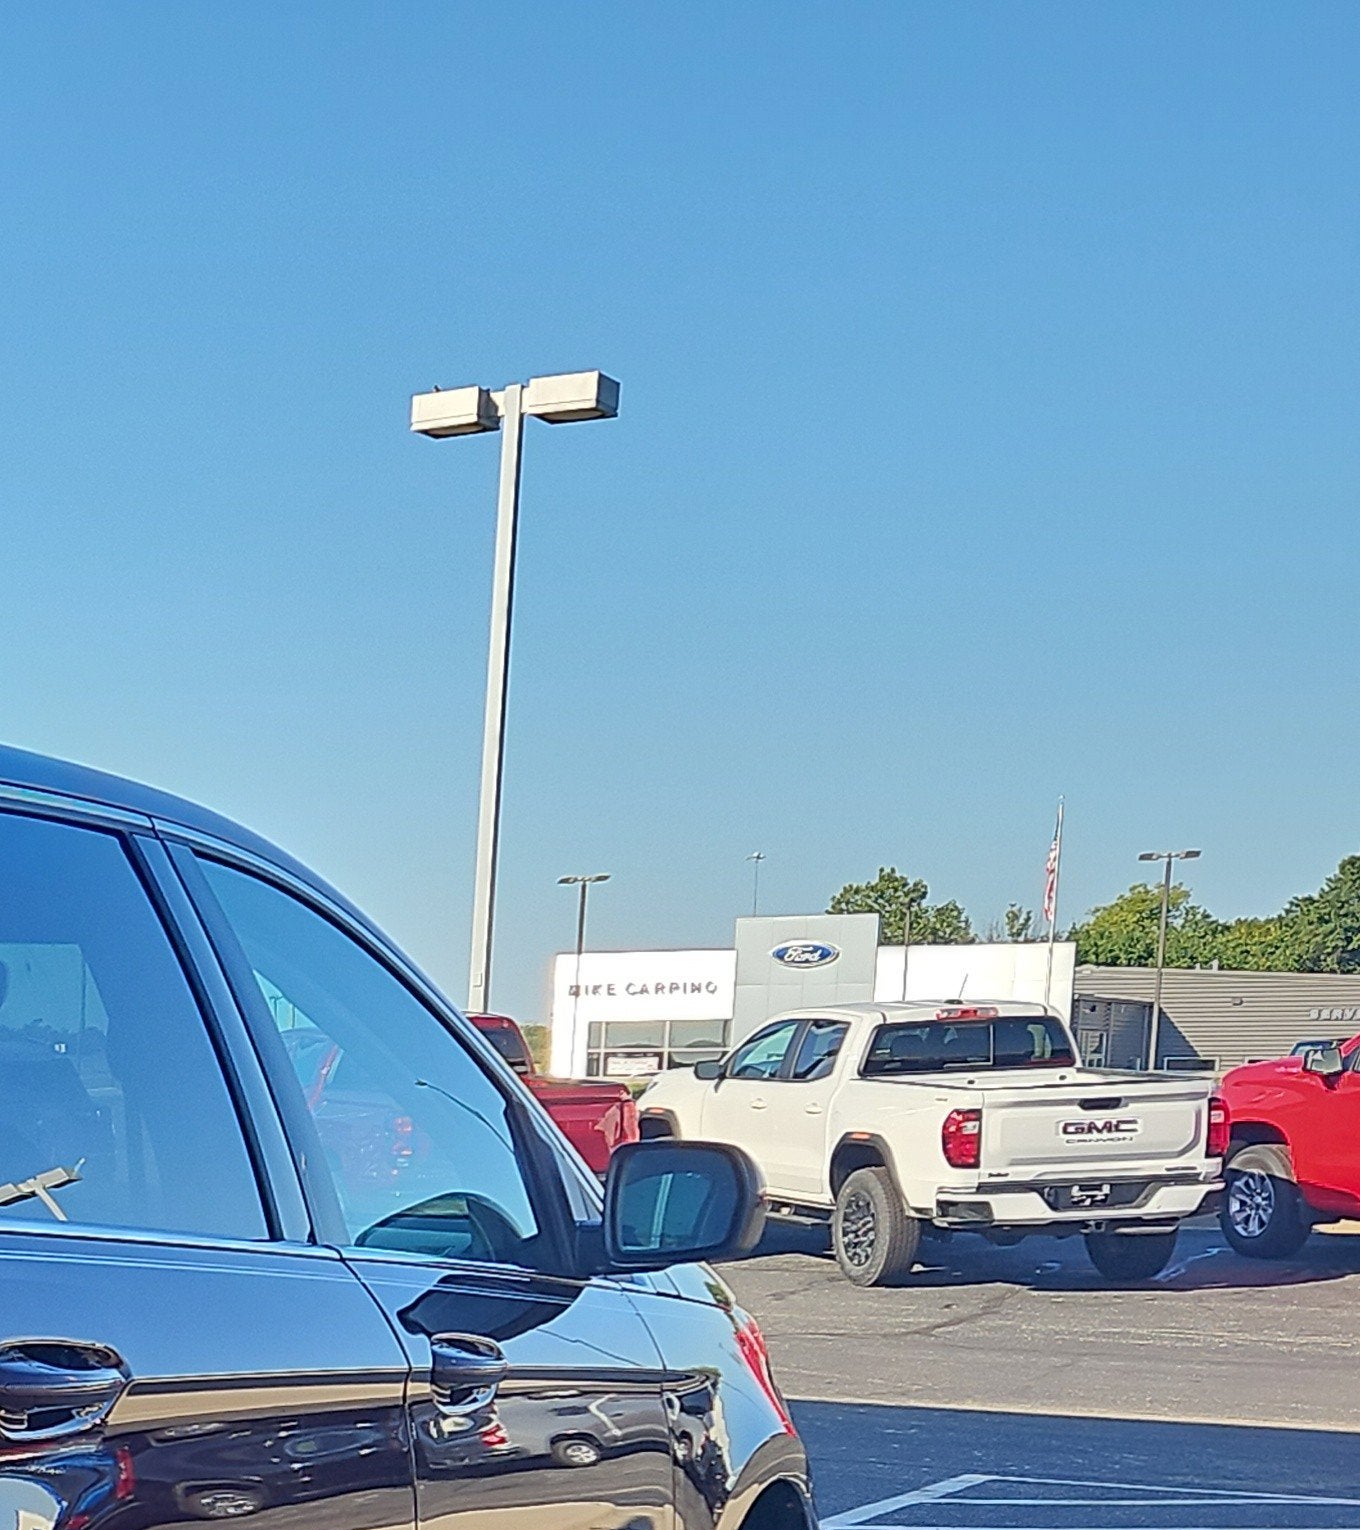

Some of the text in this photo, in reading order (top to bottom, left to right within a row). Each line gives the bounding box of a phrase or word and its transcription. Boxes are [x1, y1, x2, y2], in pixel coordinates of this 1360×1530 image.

[783, 945, 823, 962] Ford
[625, 981, 718, 996] CARPINO
[1062, 1119, 1138, 1135] GMC
